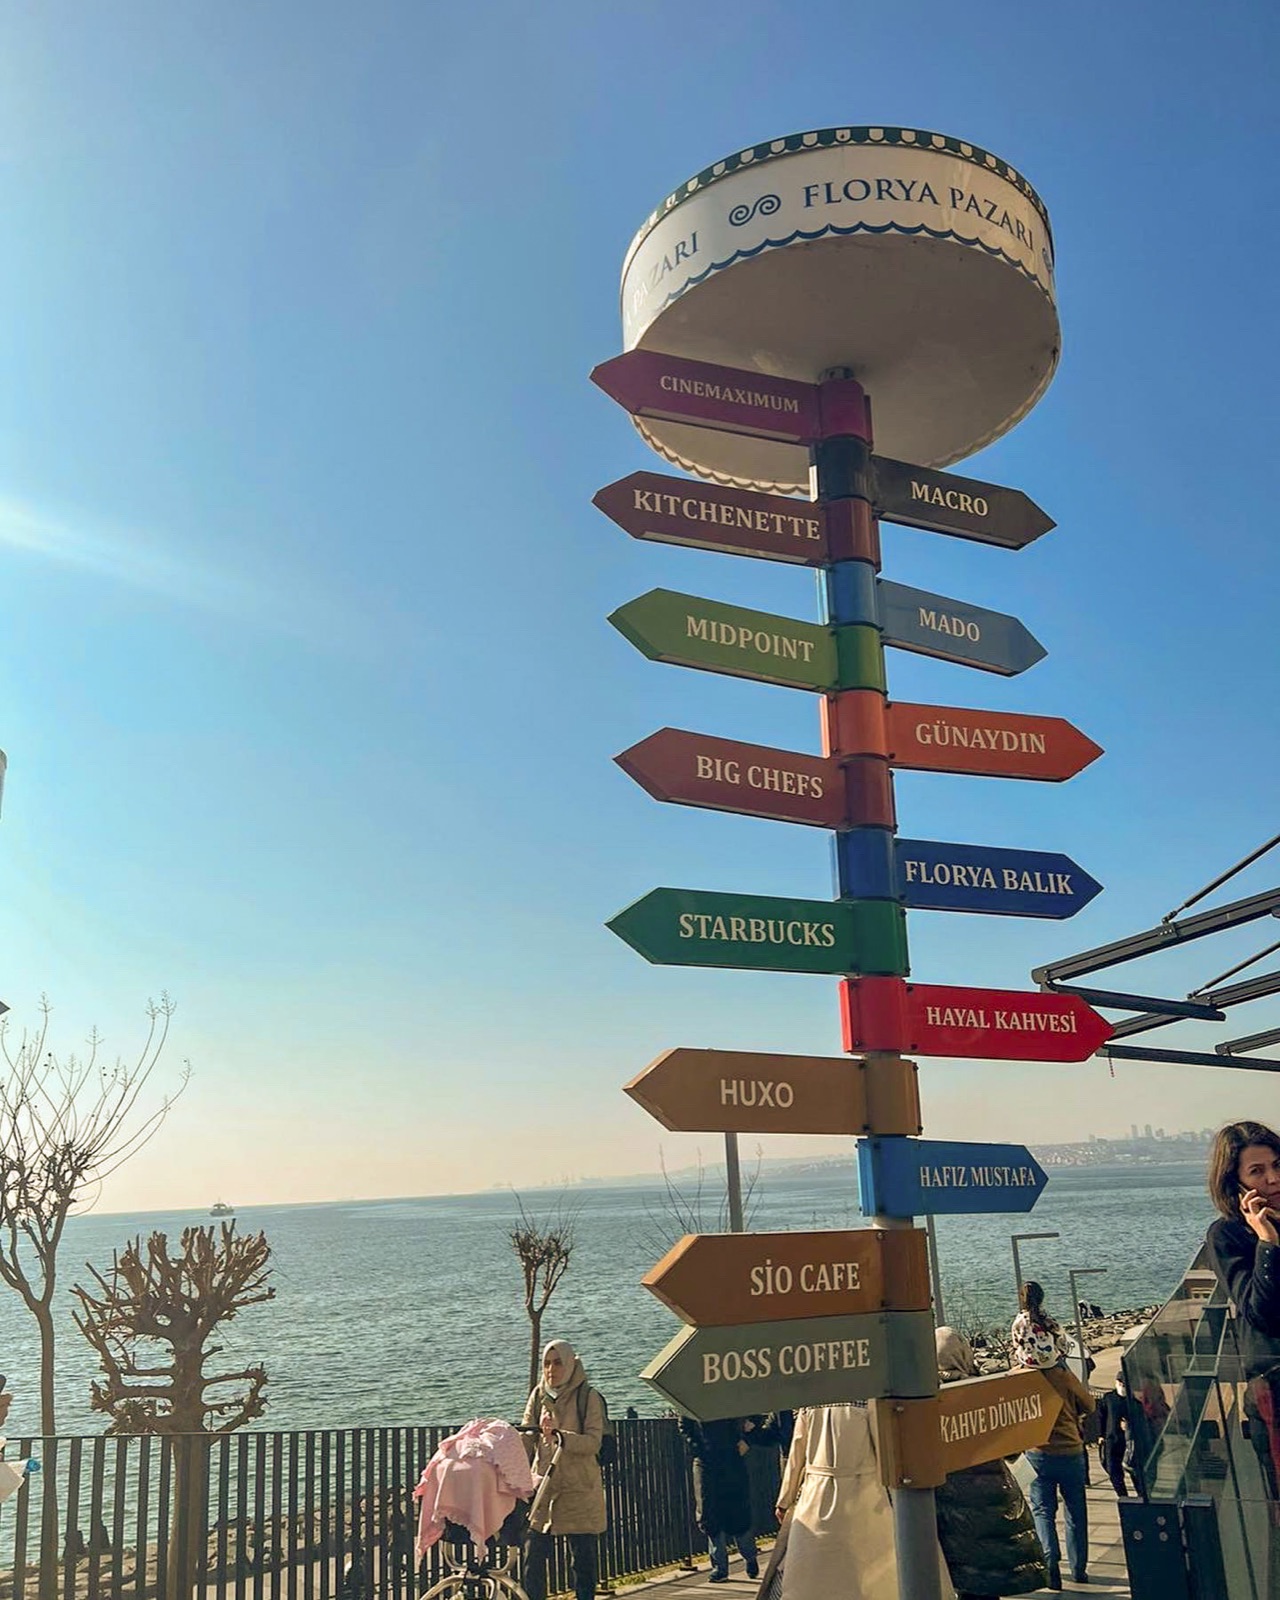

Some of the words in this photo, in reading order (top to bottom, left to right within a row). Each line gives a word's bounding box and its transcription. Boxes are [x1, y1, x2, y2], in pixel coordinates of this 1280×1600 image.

[803, 179, 940, 208] FLORYA
[949, 187, 1035, 252] PAZARI
[660, 374, 800, 414] CINEMAXIMUM
[633, 489, 820, 540] KITCHENETTE
[911, 481, 989, 517] MACRO
[686, 615, 815, 663] MIDPOINT
[919, 608, 980, 642] MADO
[915, 721, 1046, 755] GÜNAYDIN
[696, 755, 741, 786] BIG
[747, 764, 823, 800] CHEFS
[905, 860, 998, 889] FLORYA
[1003, 868, 1074, 895] BALIK
[679, 913, 836, 947] STARBUCKS
[926, 1006, 990, 1030] HAYAL
[994, 1009, 1078, 1034] KAHVESİ
[720, 1079, 794, 1108] HUXO
[919, 1166, 968, 1187] HAFIZ
[970, 1166, 1036, 1187] MUSTAFA
[750, 1258, 793, 1297] SİO
[800, 1262, 861, 1294] CAFE
[702, 1347, 771, 1384] BOSS
[778, 1339, 871, 1375] COFFEE
[940, 1407, 987, 1443] KAHVE
[989, 1394, 1043, 1430] DÜNYASI
